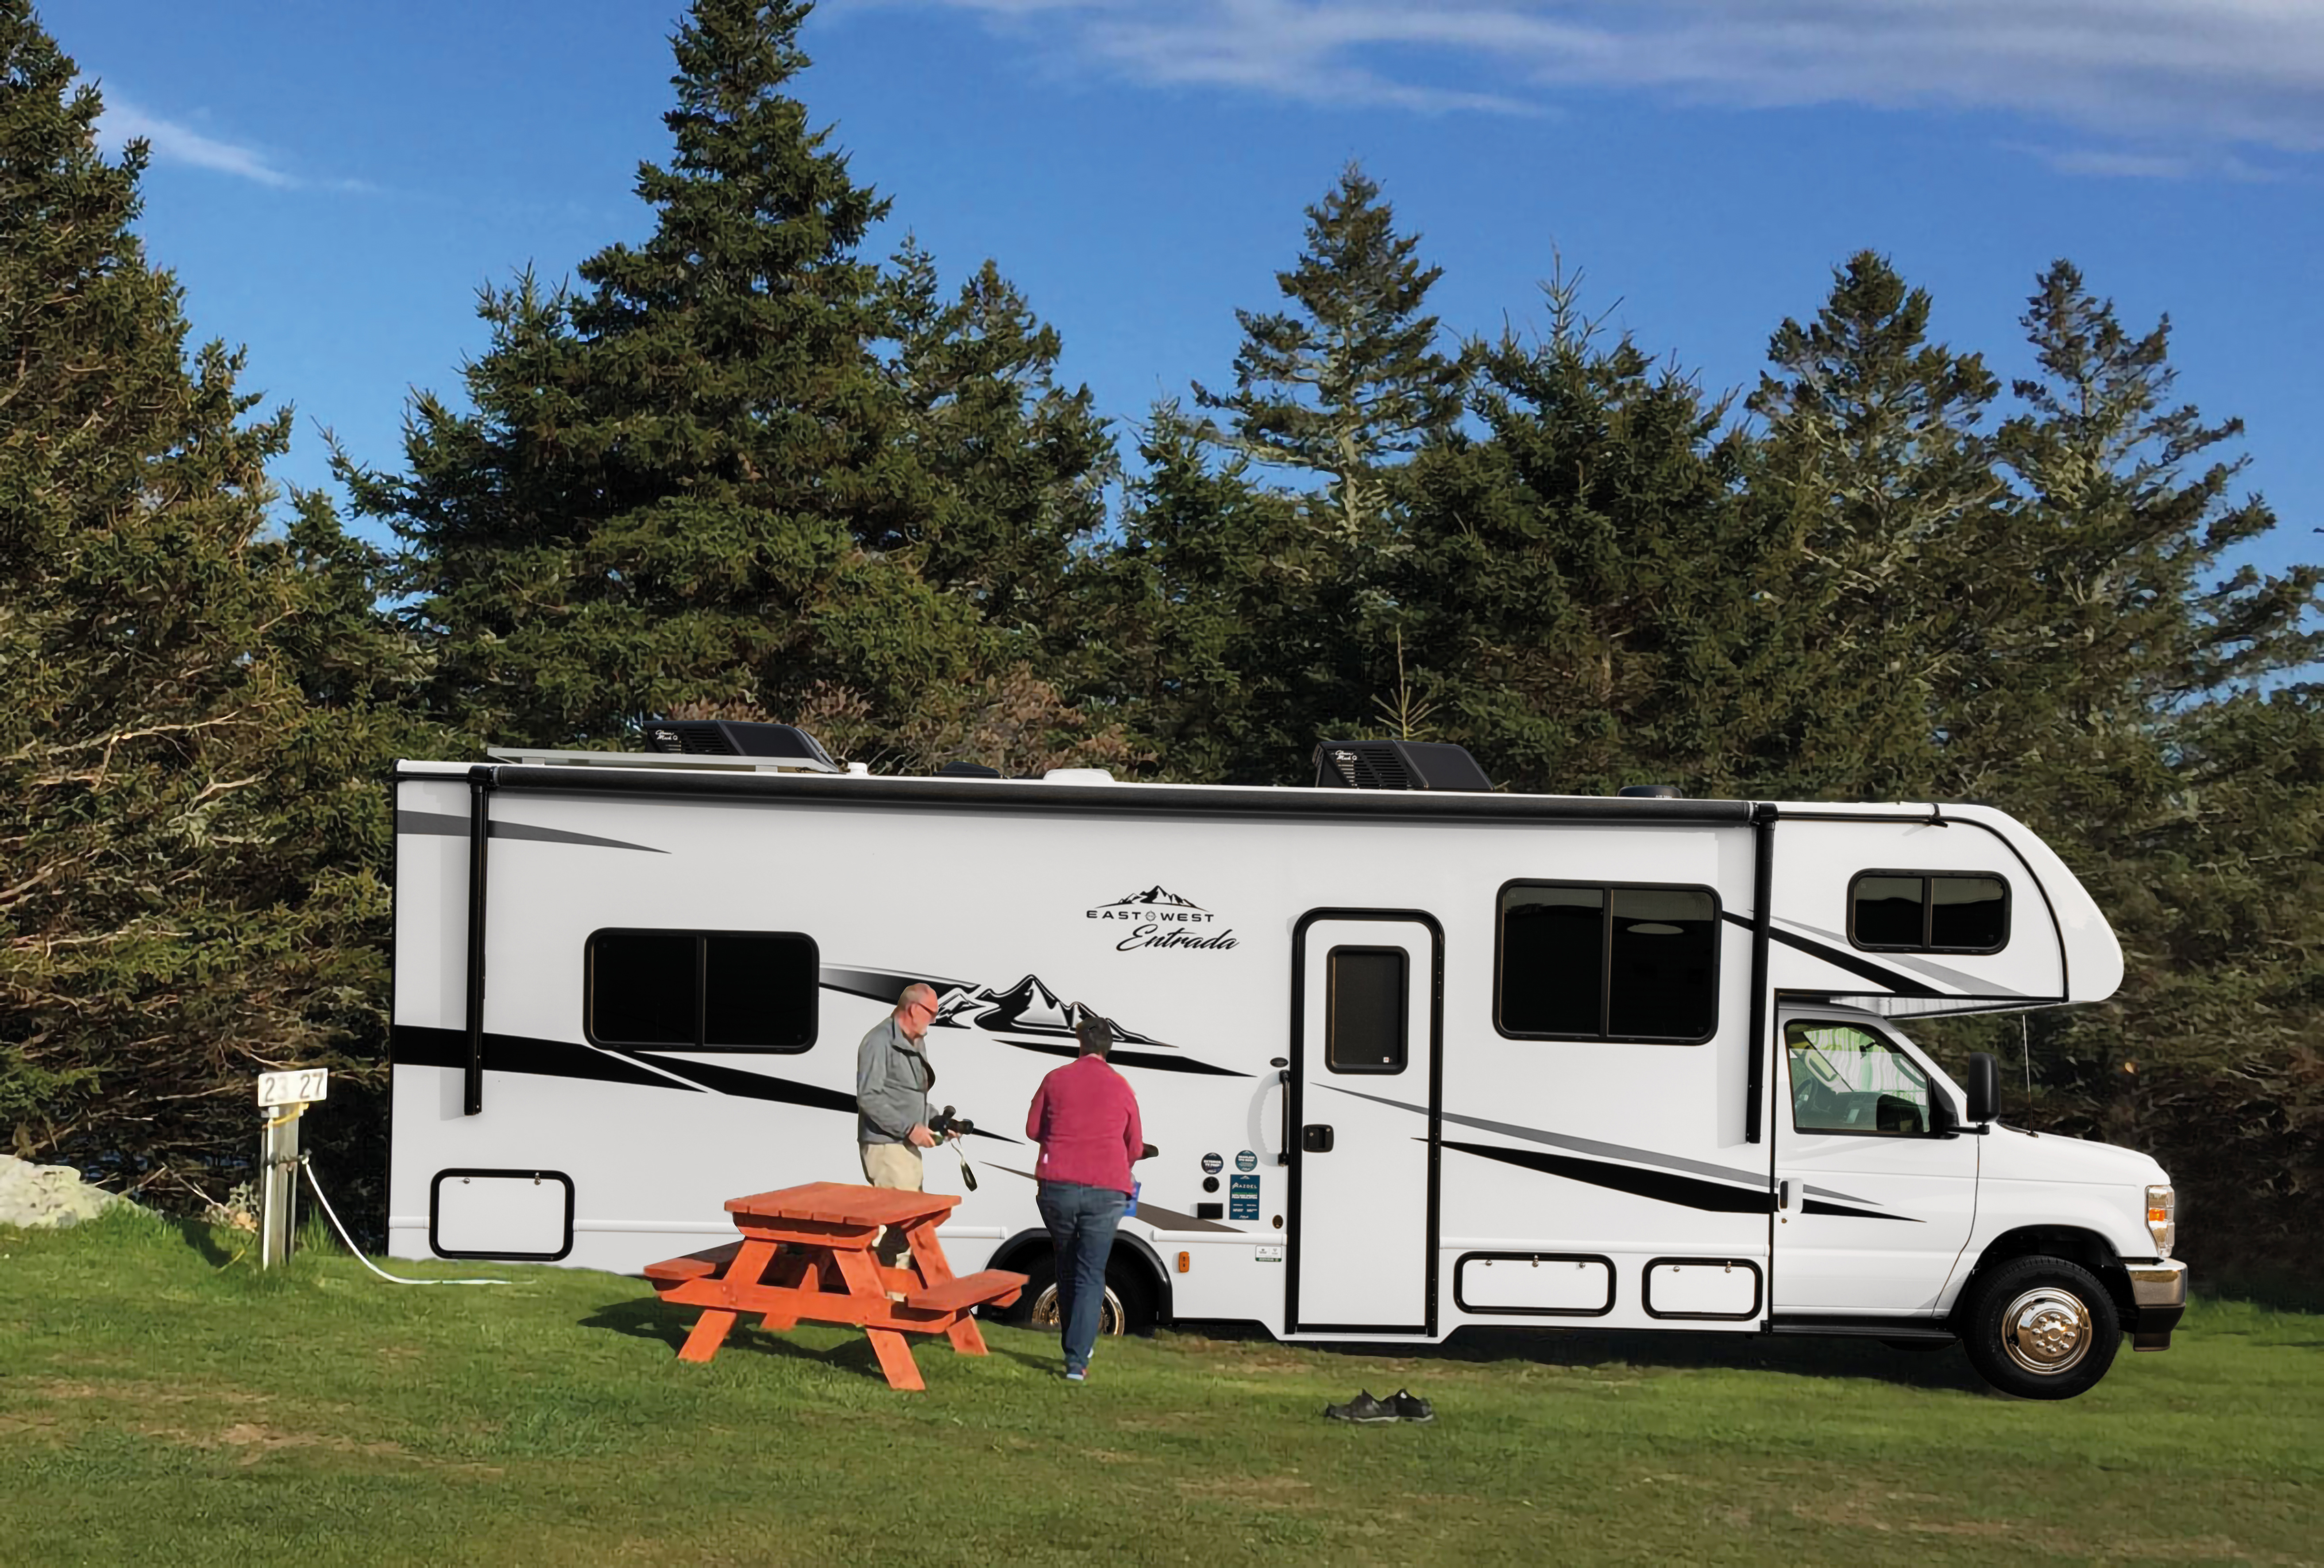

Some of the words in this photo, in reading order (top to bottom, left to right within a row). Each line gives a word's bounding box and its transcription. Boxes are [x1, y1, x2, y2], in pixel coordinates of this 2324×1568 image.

[1086, 910, 1141, 920] EAST
[1160, 912, 1214, 922] WEST
[1116, 923, 1240, 952] Entrada
[299, 1072, 324, 1099] 27
